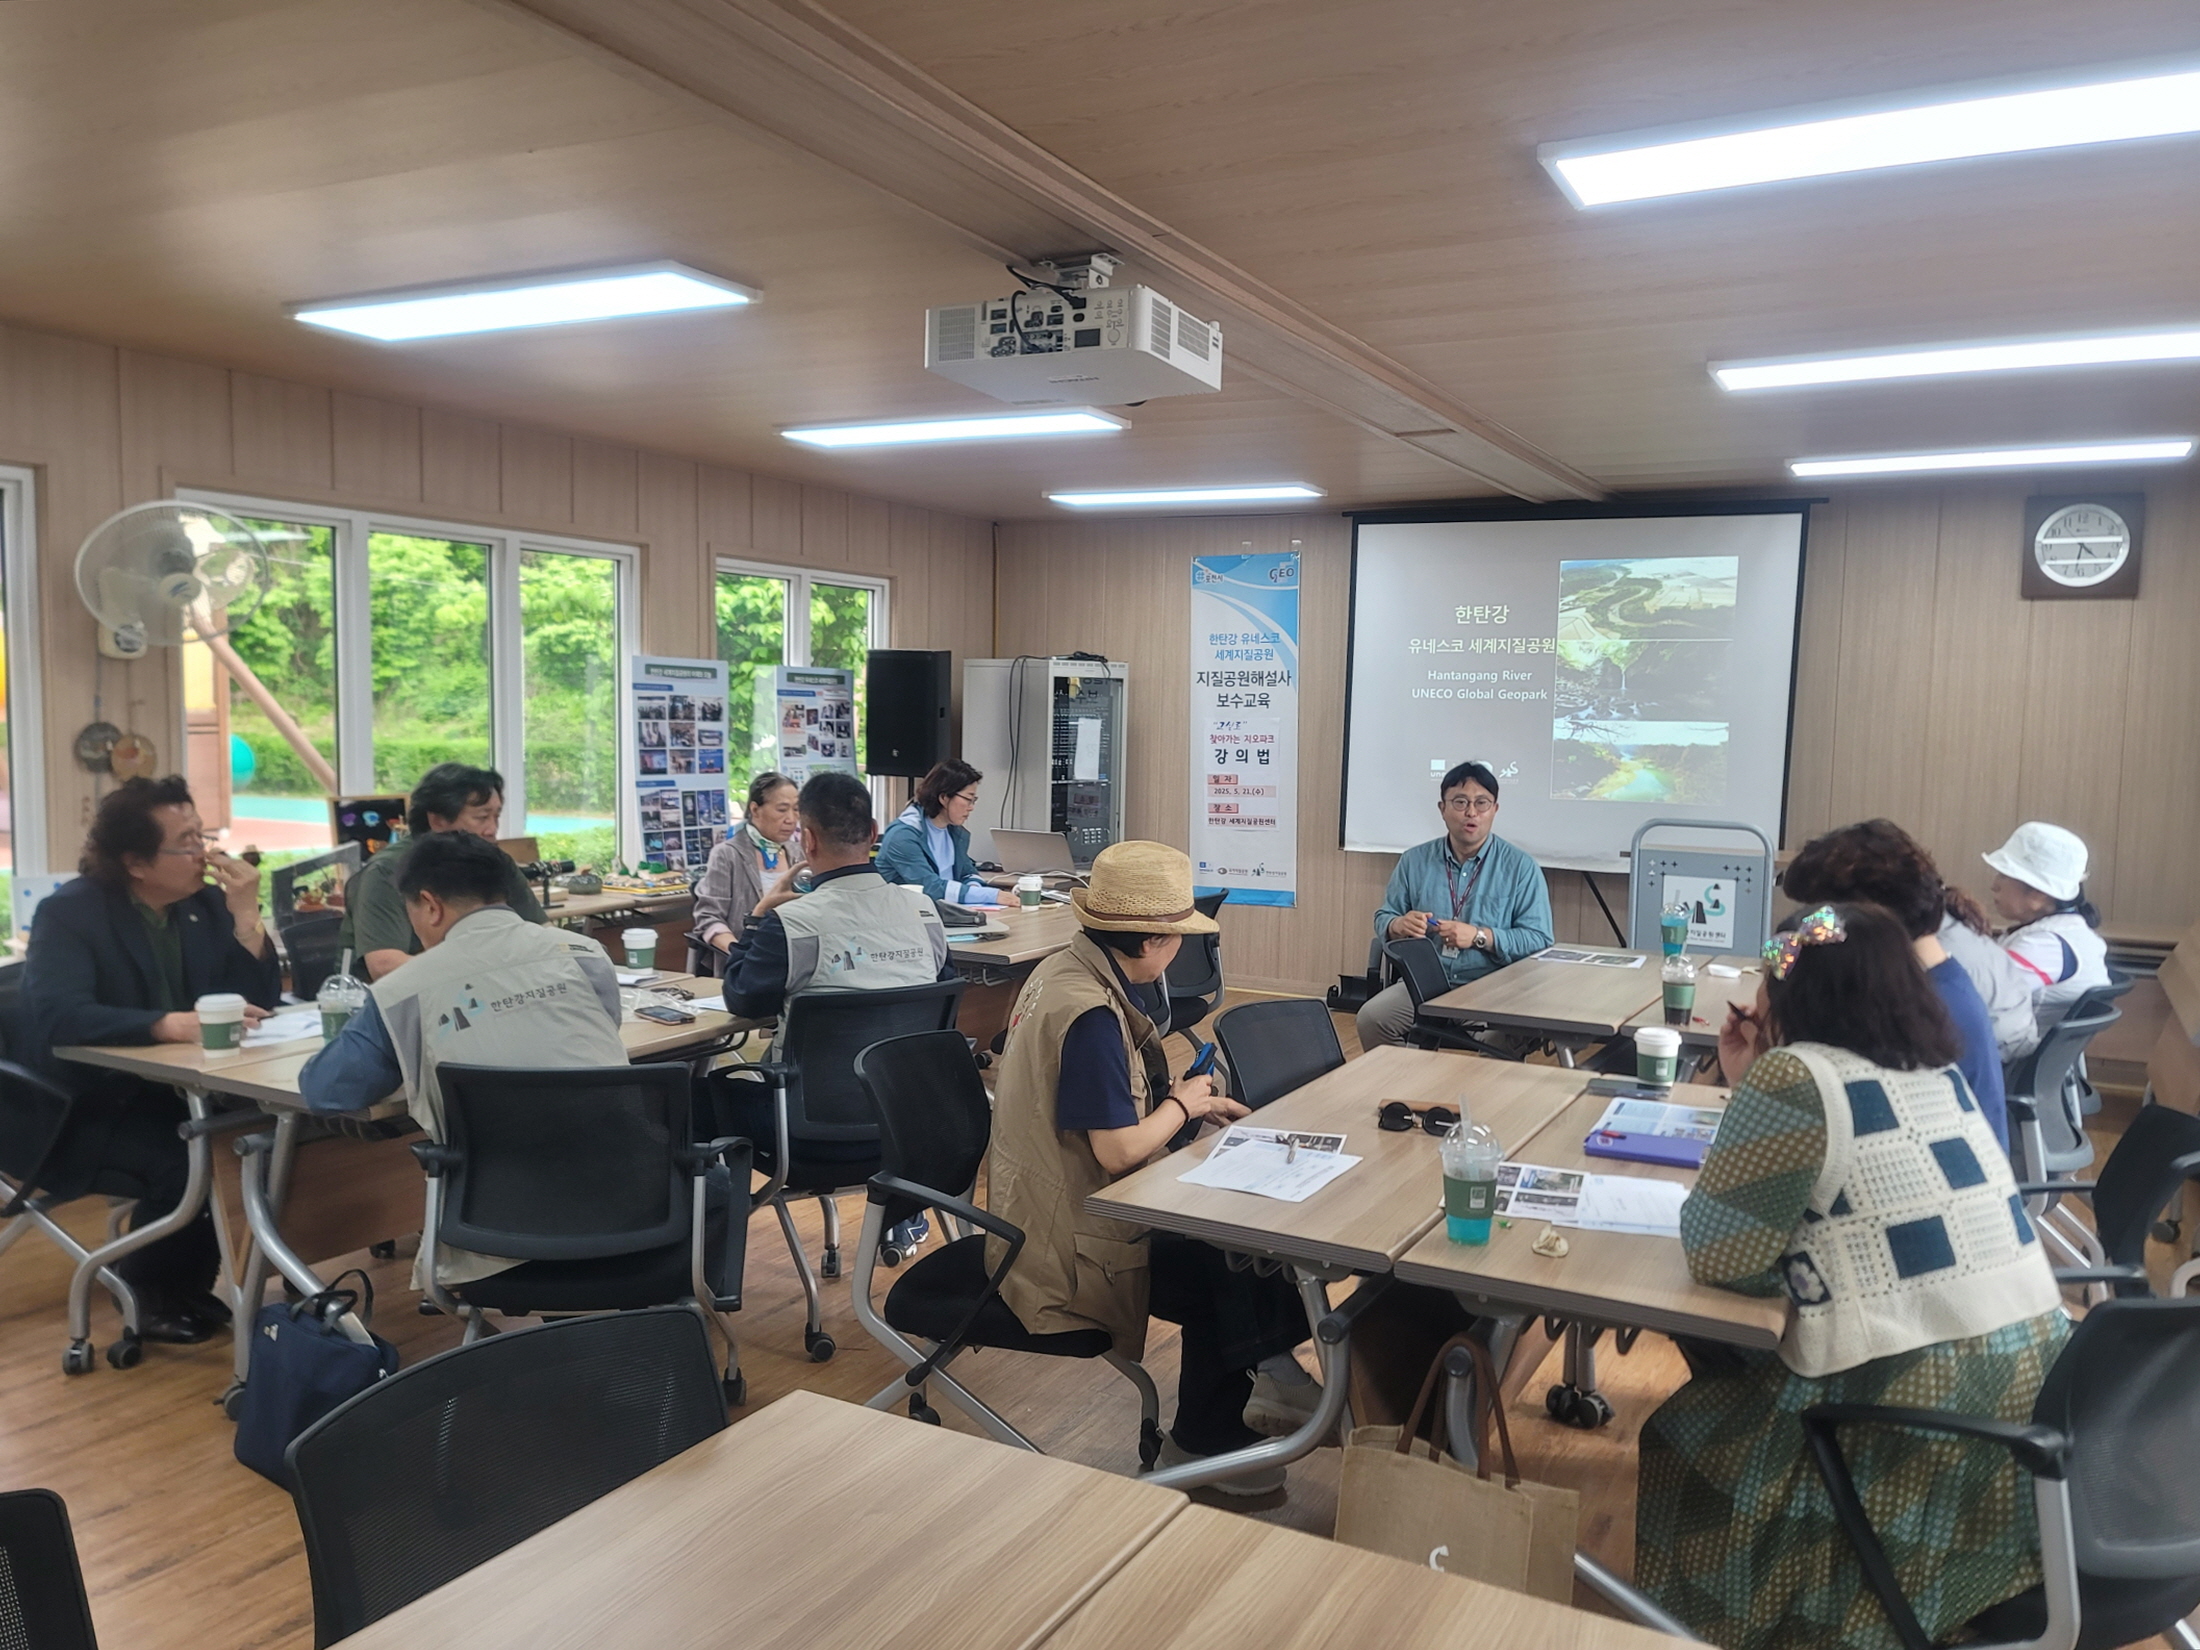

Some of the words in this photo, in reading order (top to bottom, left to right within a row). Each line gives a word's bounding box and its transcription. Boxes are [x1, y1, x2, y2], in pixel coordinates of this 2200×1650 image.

[2077, 513, 2089, 524] 12
[1455, 605, 1510, 624] 한탄강
[1209, 633, 1238, 646] 한탄강
[1240, 632, 1281, 645] 유네스코
[1408, 638, 1465, 654] 유네스코
[1468, 637, 1556, 654] 세계지질공원
[1215, 648, 1274, 661] 세계지질공원
[1196, 670, 1292, 687] 지질공원해설사
[1428, 670, 1498, 683] Hantangang
[1502, 670, 1532, 681] River
[1216, 692, 1271, 709] 보수교육
[1412, 688, 1453, 699] UNECO
[1457, 689, 1494, 699] Global
[1498, 689, 1548, 702] Geopark
[1210, 733, 1241, 745] 찾아가는
[1244, 734, 1275, 744] 지오파크
[1215, 748, 1228, 765] 강
[1235, 748, 1248, 764] 의
[1257, 748, 1270, 765] 법
[870, 947, 924, 963] 한탄강지질공원
[490, 982, 568, 1012] 한탄강지질공원
